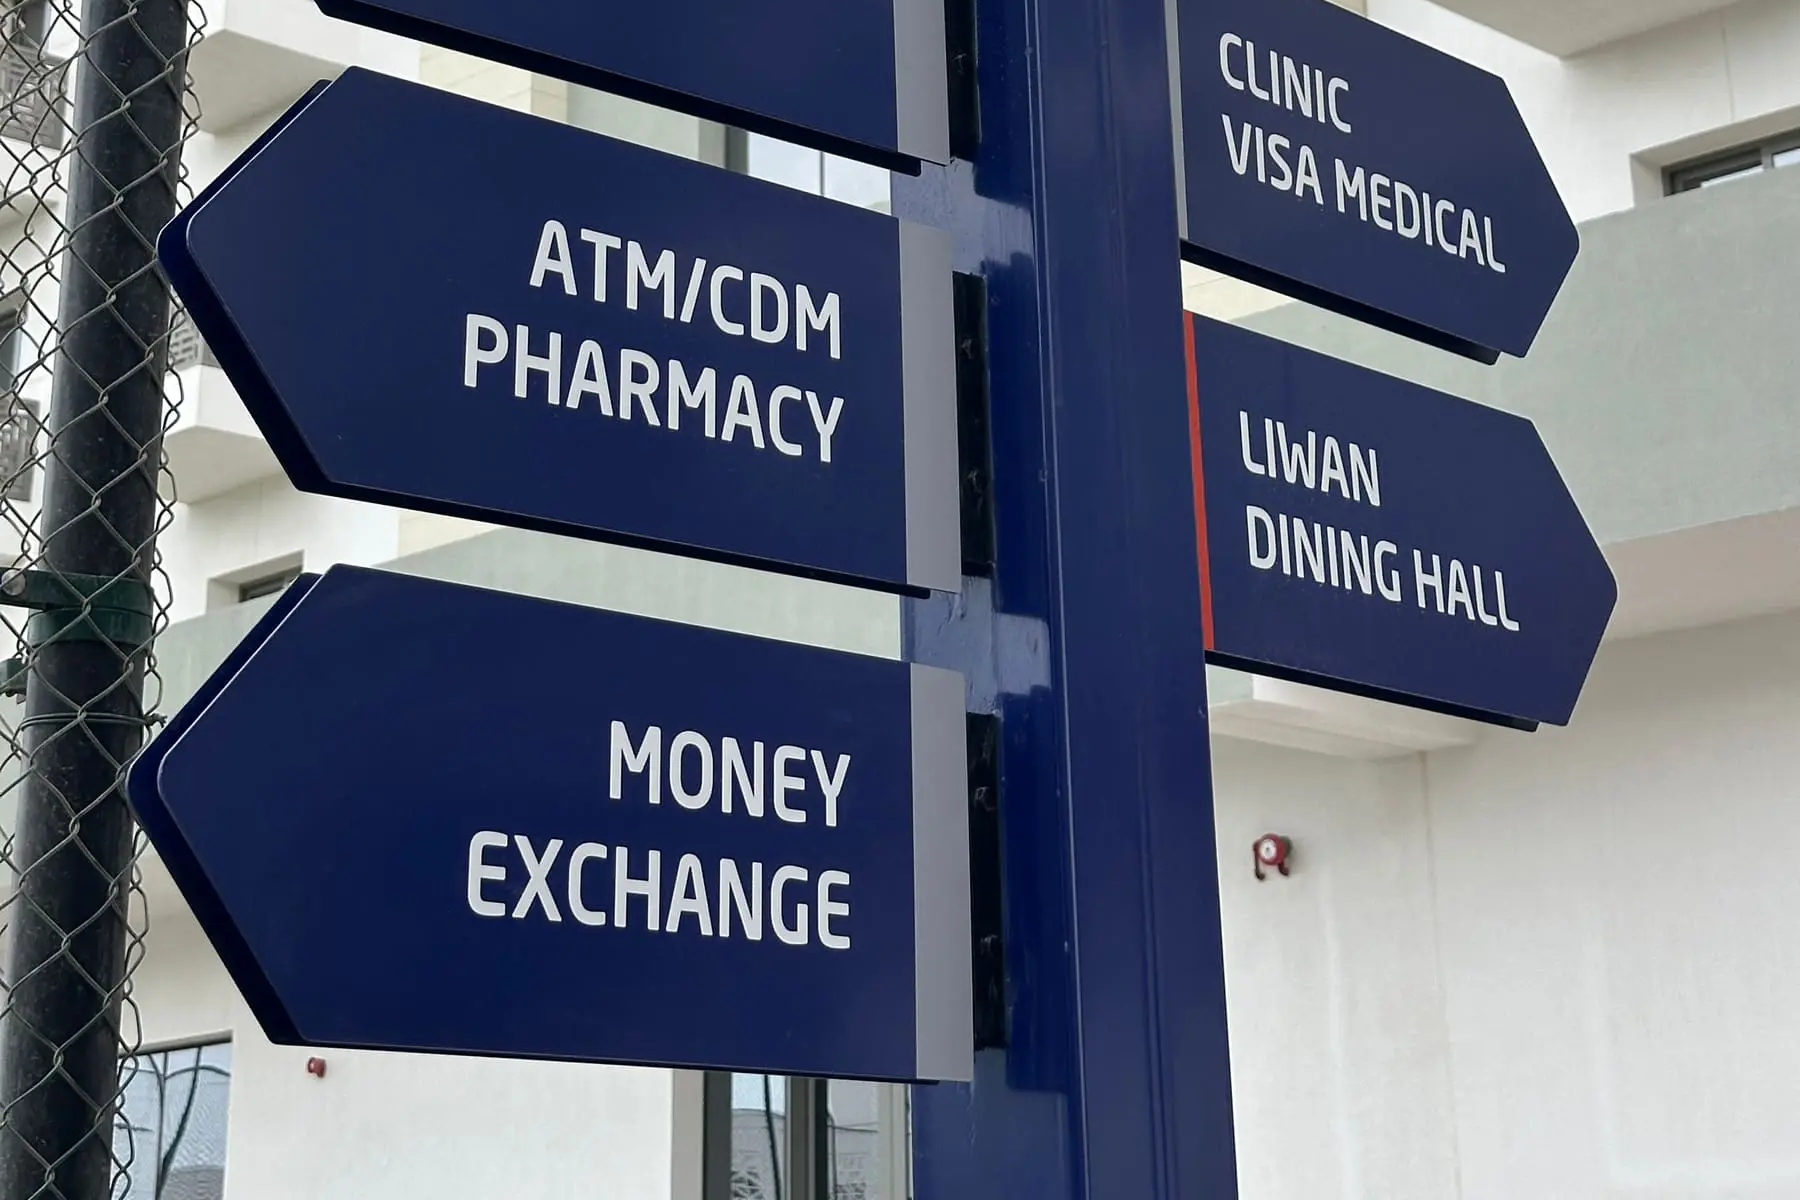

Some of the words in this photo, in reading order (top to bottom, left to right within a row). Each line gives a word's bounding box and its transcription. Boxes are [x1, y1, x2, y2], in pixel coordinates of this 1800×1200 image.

[1218, 31, 1353, 135] CLINIC
[1220, 112, 1325, 206] VISA
[1333, 157, 1507, 274] MEDICAL
[528, 218, 842, 361] ATM/CDM
[463, 312, 846, 464] PHARMACY
[1238, 409, 1382, 508] LIWAN
[1245, 504, 1403, 603] DINING
[1412, 548, 1521, 633] HALL
[608, 719, 852, 828] MONEY
[466, 829, 852, 951] EXCHANGE
